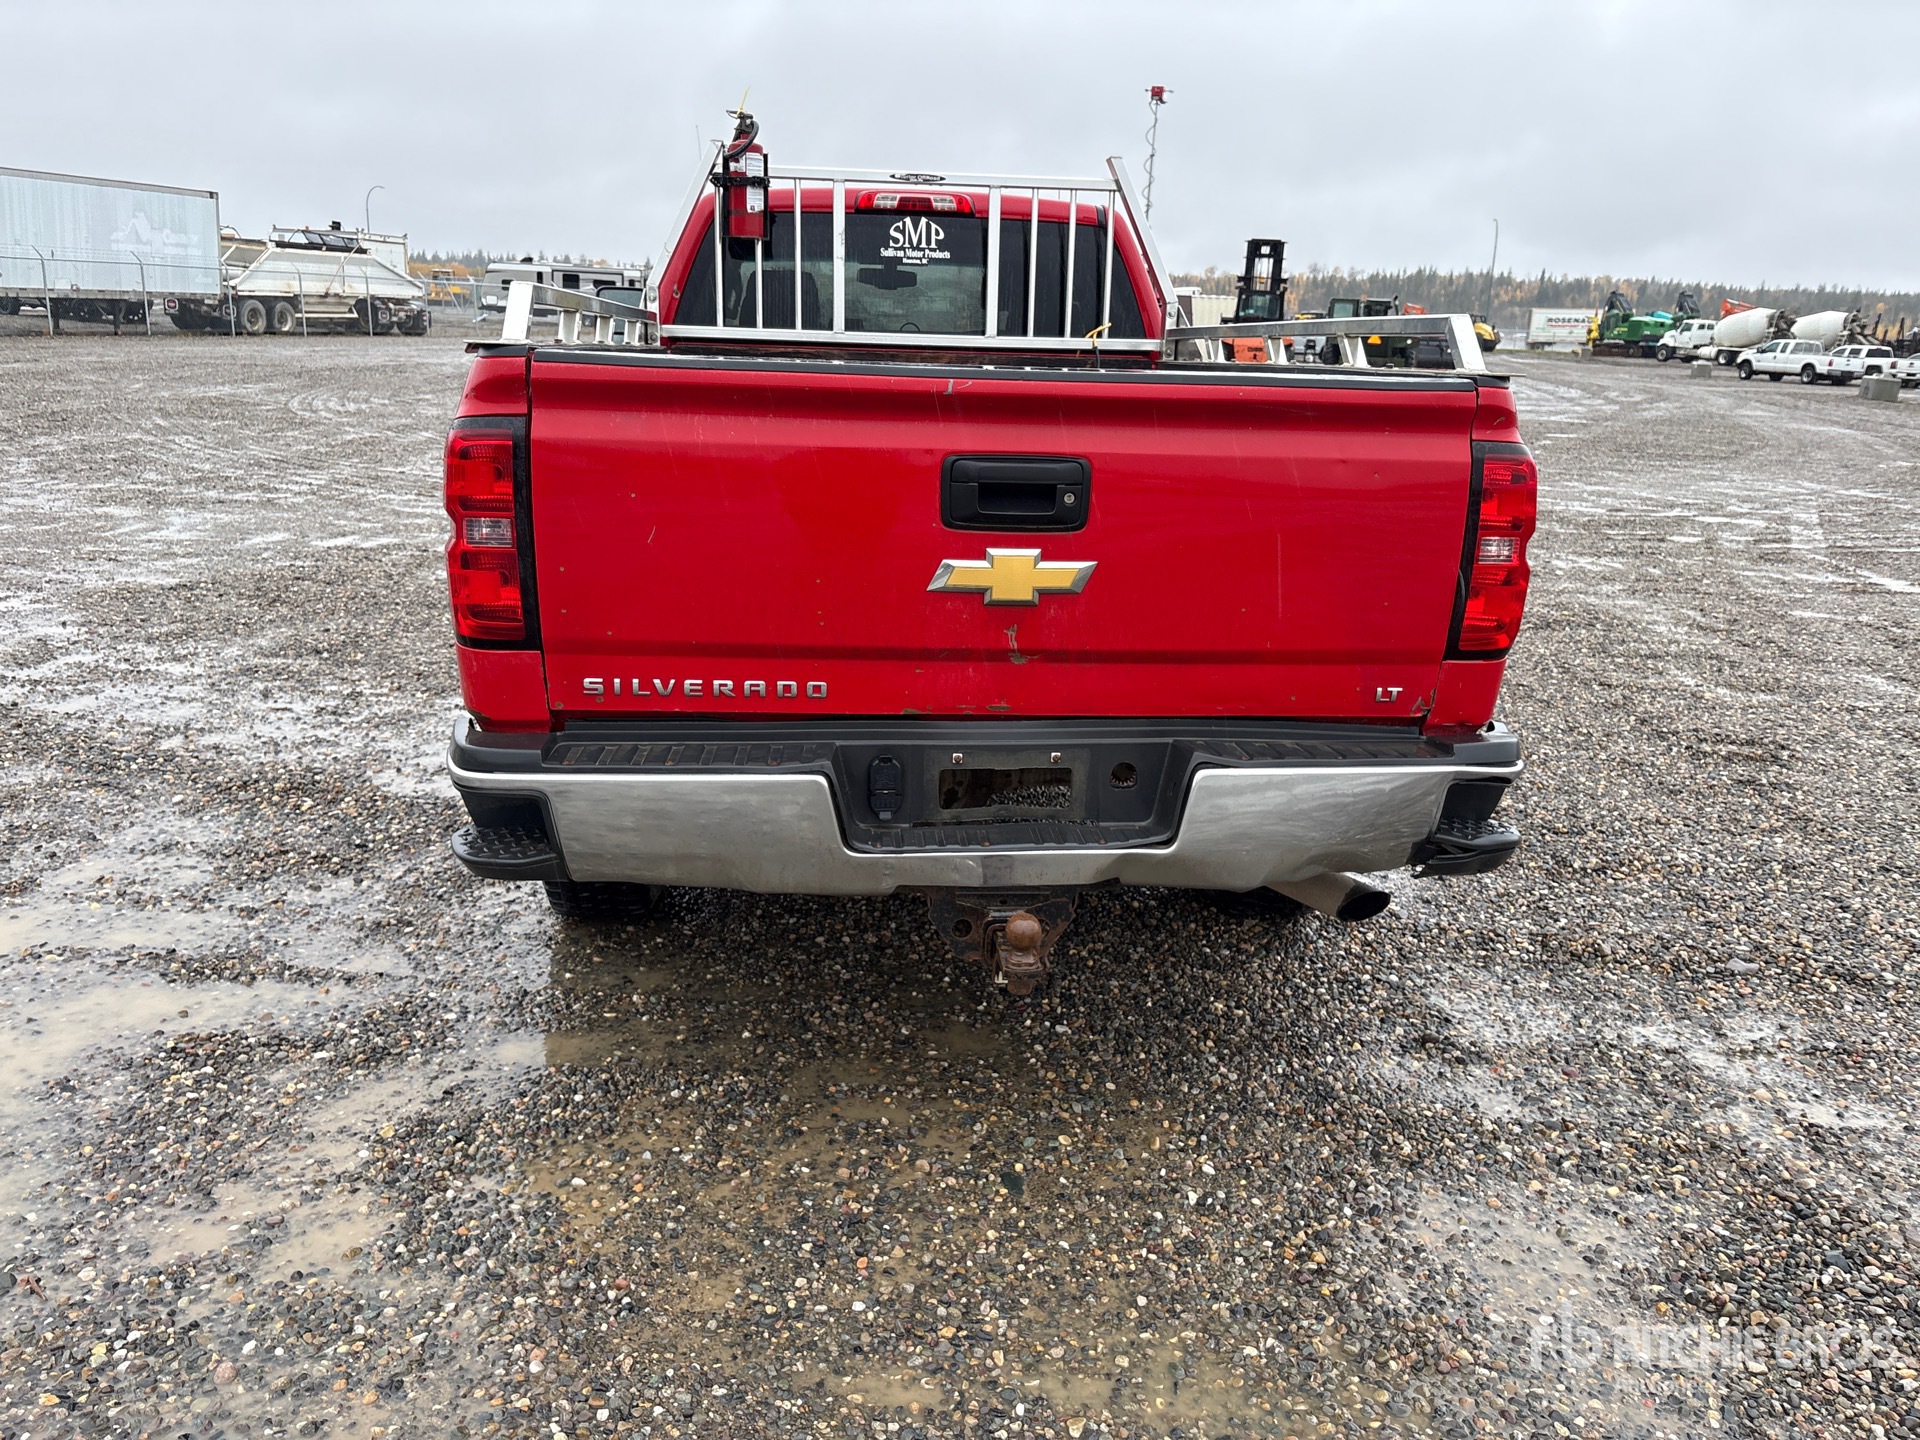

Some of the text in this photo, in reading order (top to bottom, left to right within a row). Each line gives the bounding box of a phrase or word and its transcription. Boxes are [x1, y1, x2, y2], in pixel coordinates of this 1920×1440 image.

[889, 216, 945, 249] SMP
[880, 247, 951, 259] Sullivan Motor Products
[583, 677, 829, 699] SILVERADO
[1375, 687, 1404, 702] LT
